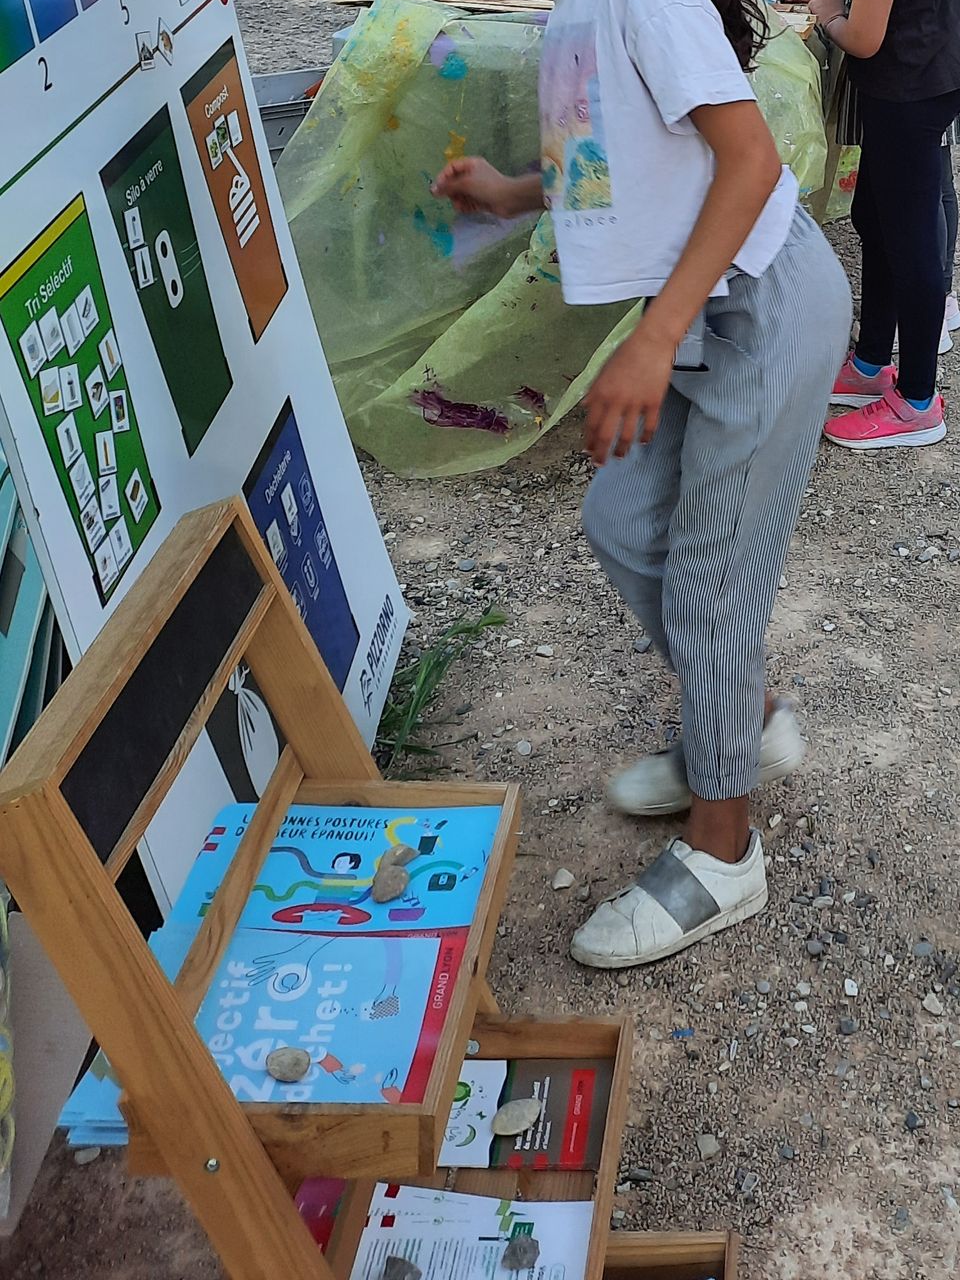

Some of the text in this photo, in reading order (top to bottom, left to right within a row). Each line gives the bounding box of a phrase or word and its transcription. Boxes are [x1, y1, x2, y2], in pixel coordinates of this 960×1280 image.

[38, 56, 53, 91] 2
[204, 84, 229, 118] Compost
[125, 160, 163, 206] Silo à verre
[24, 292, 41, 318] Tri
[366, 593, 394, 678] PIZZORNO
[324, 816, 389, 829] POSTURES
[432, 972, 450, 1009] GRAND
